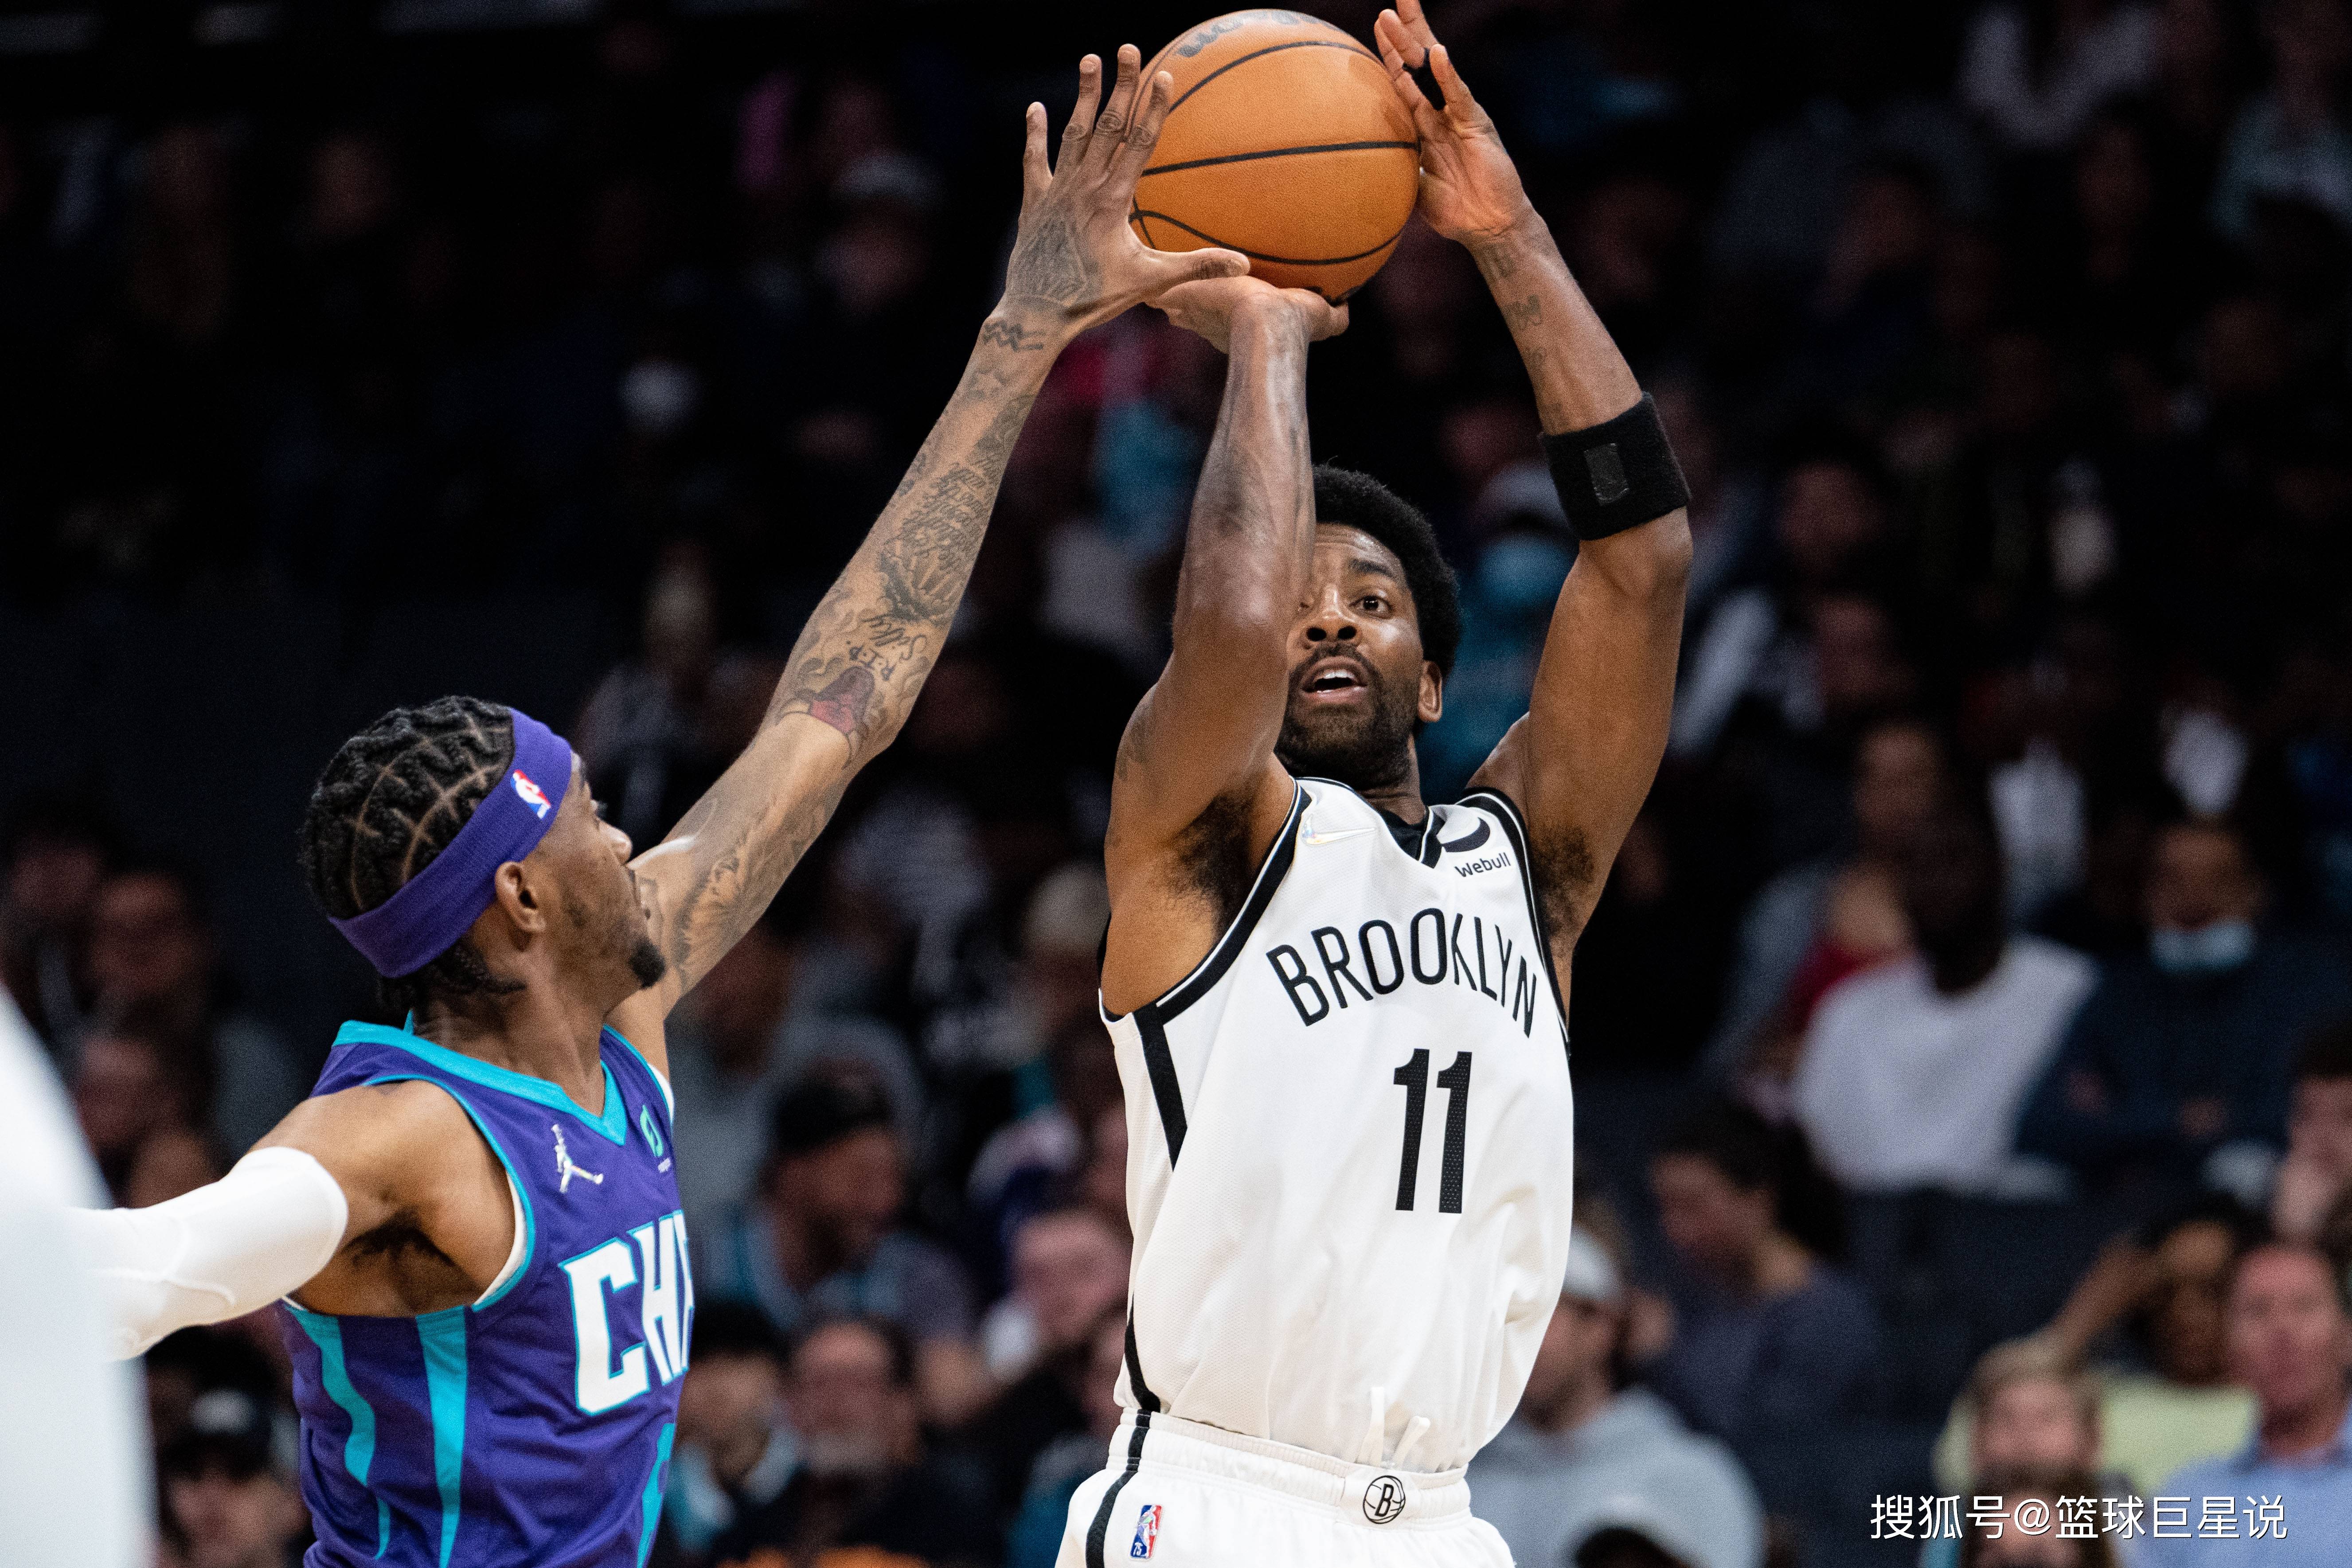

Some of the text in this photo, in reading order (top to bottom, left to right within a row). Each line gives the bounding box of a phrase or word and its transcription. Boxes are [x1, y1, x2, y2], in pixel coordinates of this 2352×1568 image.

[1454, 852, 1511, 878] Webull
[1266, 908, 1537, 1038] BROOKLYN
[1393, 1048, 1473, 1214] 11
[1375, 1483, 1395, 1517] B
